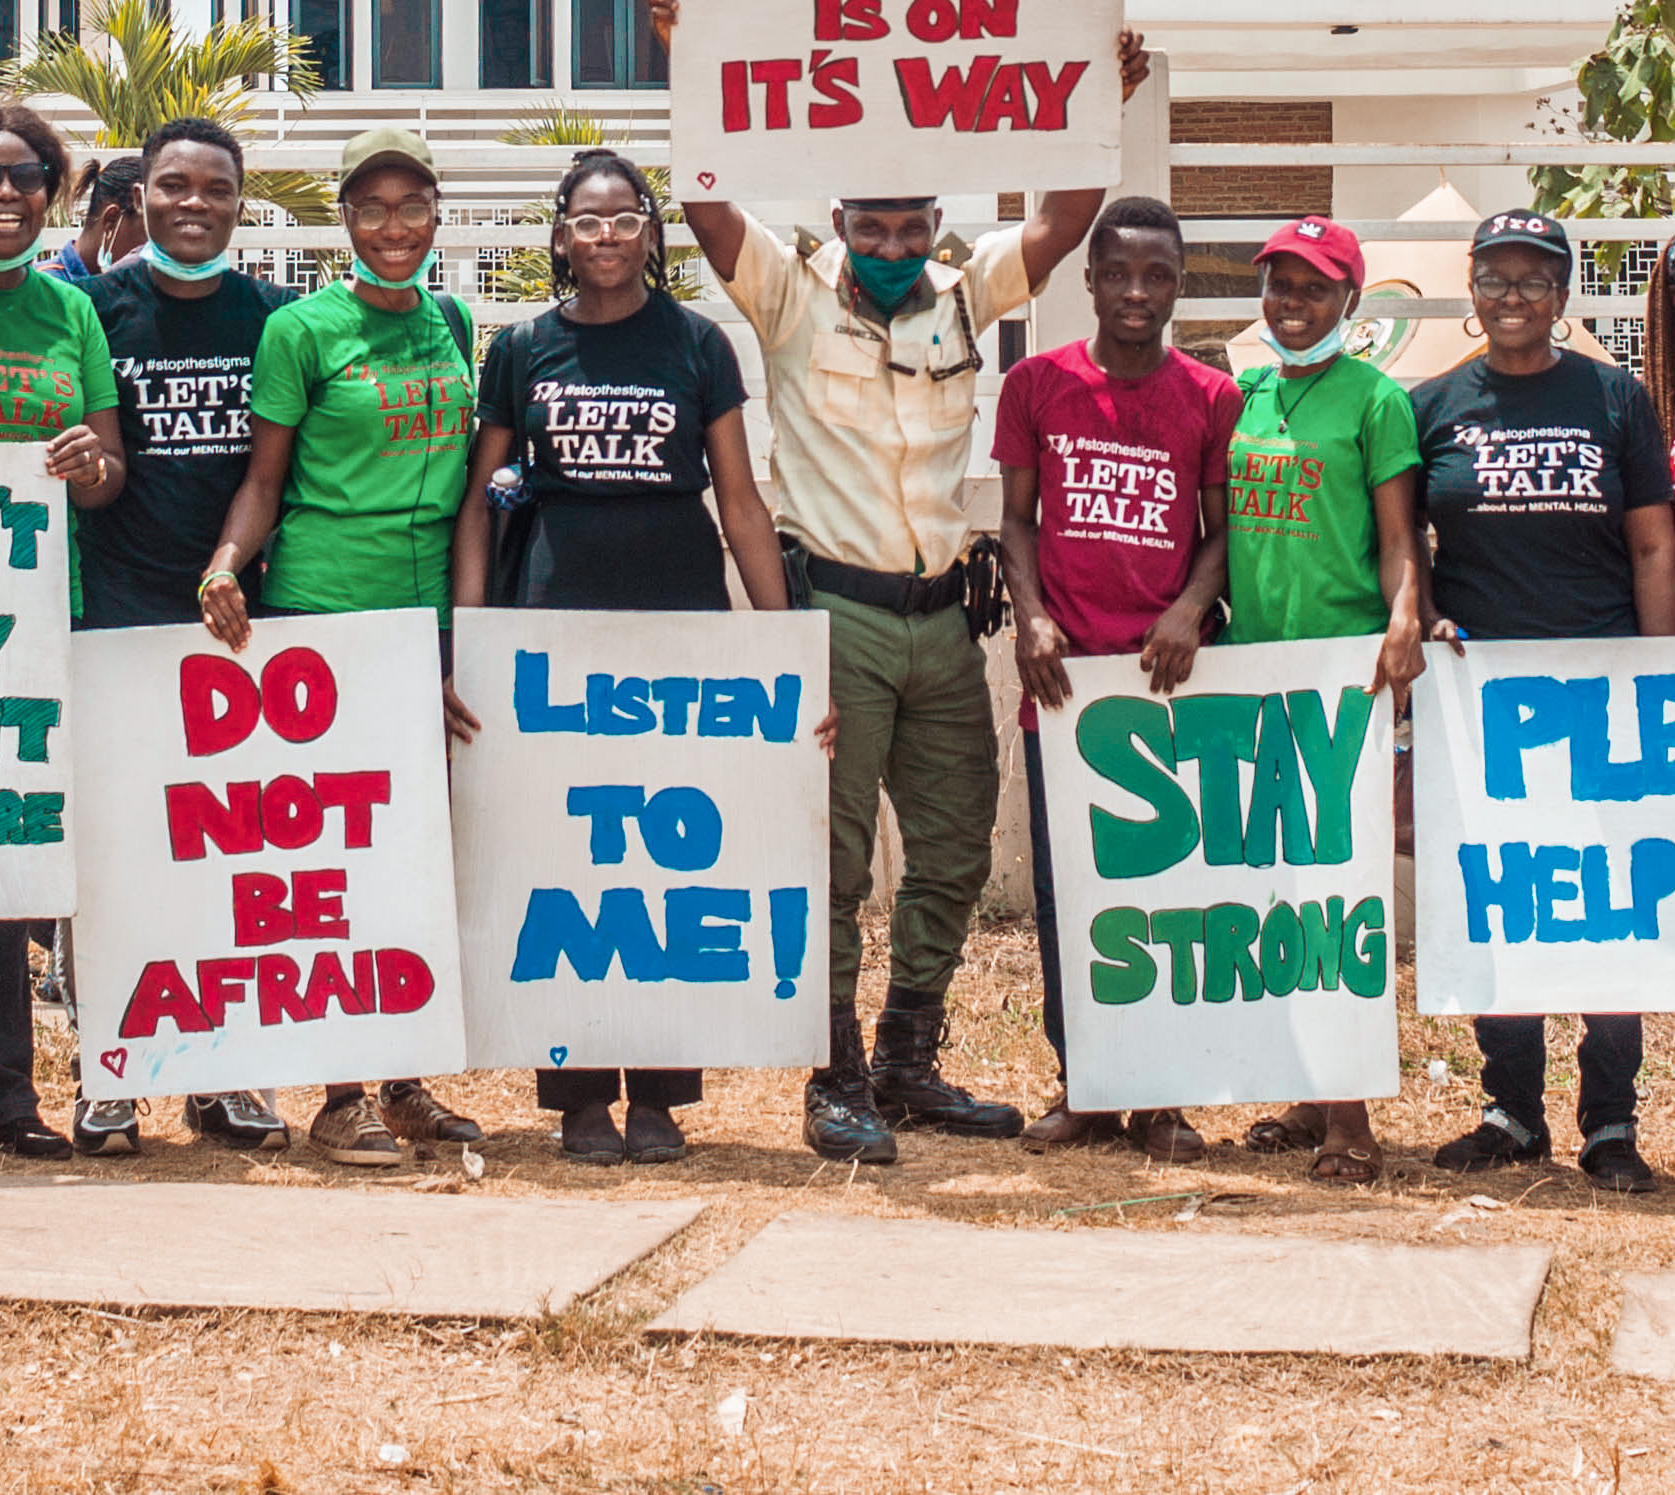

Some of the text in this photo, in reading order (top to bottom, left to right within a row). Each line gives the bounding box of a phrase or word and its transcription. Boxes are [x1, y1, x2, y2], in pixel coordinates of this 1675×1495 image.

[721, 50, 1089, 134] IT'S WAY
[146, 356, 251, 373] #stopthestigma
[133, 373, 253, 409] LET'S
[564, 384, 665, 399] #stopthestigma
[142, 409, 252, 442] TALK
[545, 401, 676, 434] LET'S
[1490, 426, 1591, 442] #stopthestigma
[173, 446, 191, 456] our
[191, 444, 229, 455] MENTAL
[551, 434, 665, 466] TALK
[1076, 437, 1170, 462] #stopthestigma
[1473, 441, 1604, 469] LET'S
[594, 470, 633, 480] MENTAL
[635, 470, 672, 482] HEALTH
[1062, 457, 1178, 502] LET'S
[1228, 450, 1325, 490] LET'S
[1477, 468, 1603, 498] TALK
[1066, 492, 1171, 534] TALK
[1229, 486, 1313, 523] TALK
[1508, 504, 1526, 512] our
[1528, 502, 1572, 512] MENTAL
[1574, 503, 1608, 513] HEALTH
[1103, 530, 1140, 546] MENTAL
[1142, 536, 1175, 550] HEALTH
[179, 645, 338, 757] DO
[514, 649, 801, 744] LISTEN
[1075, 685, 1377, 879] STAY
[165, 770, 390, 861] NOT
[566, 785, 723, 871] TO
[232, 868, 349, 947] BE
[510, 885, 807, 999] ME!
[1089, 895, 1386, 1004] STRONG
[119, 948, 435, 1041] AFRAID
